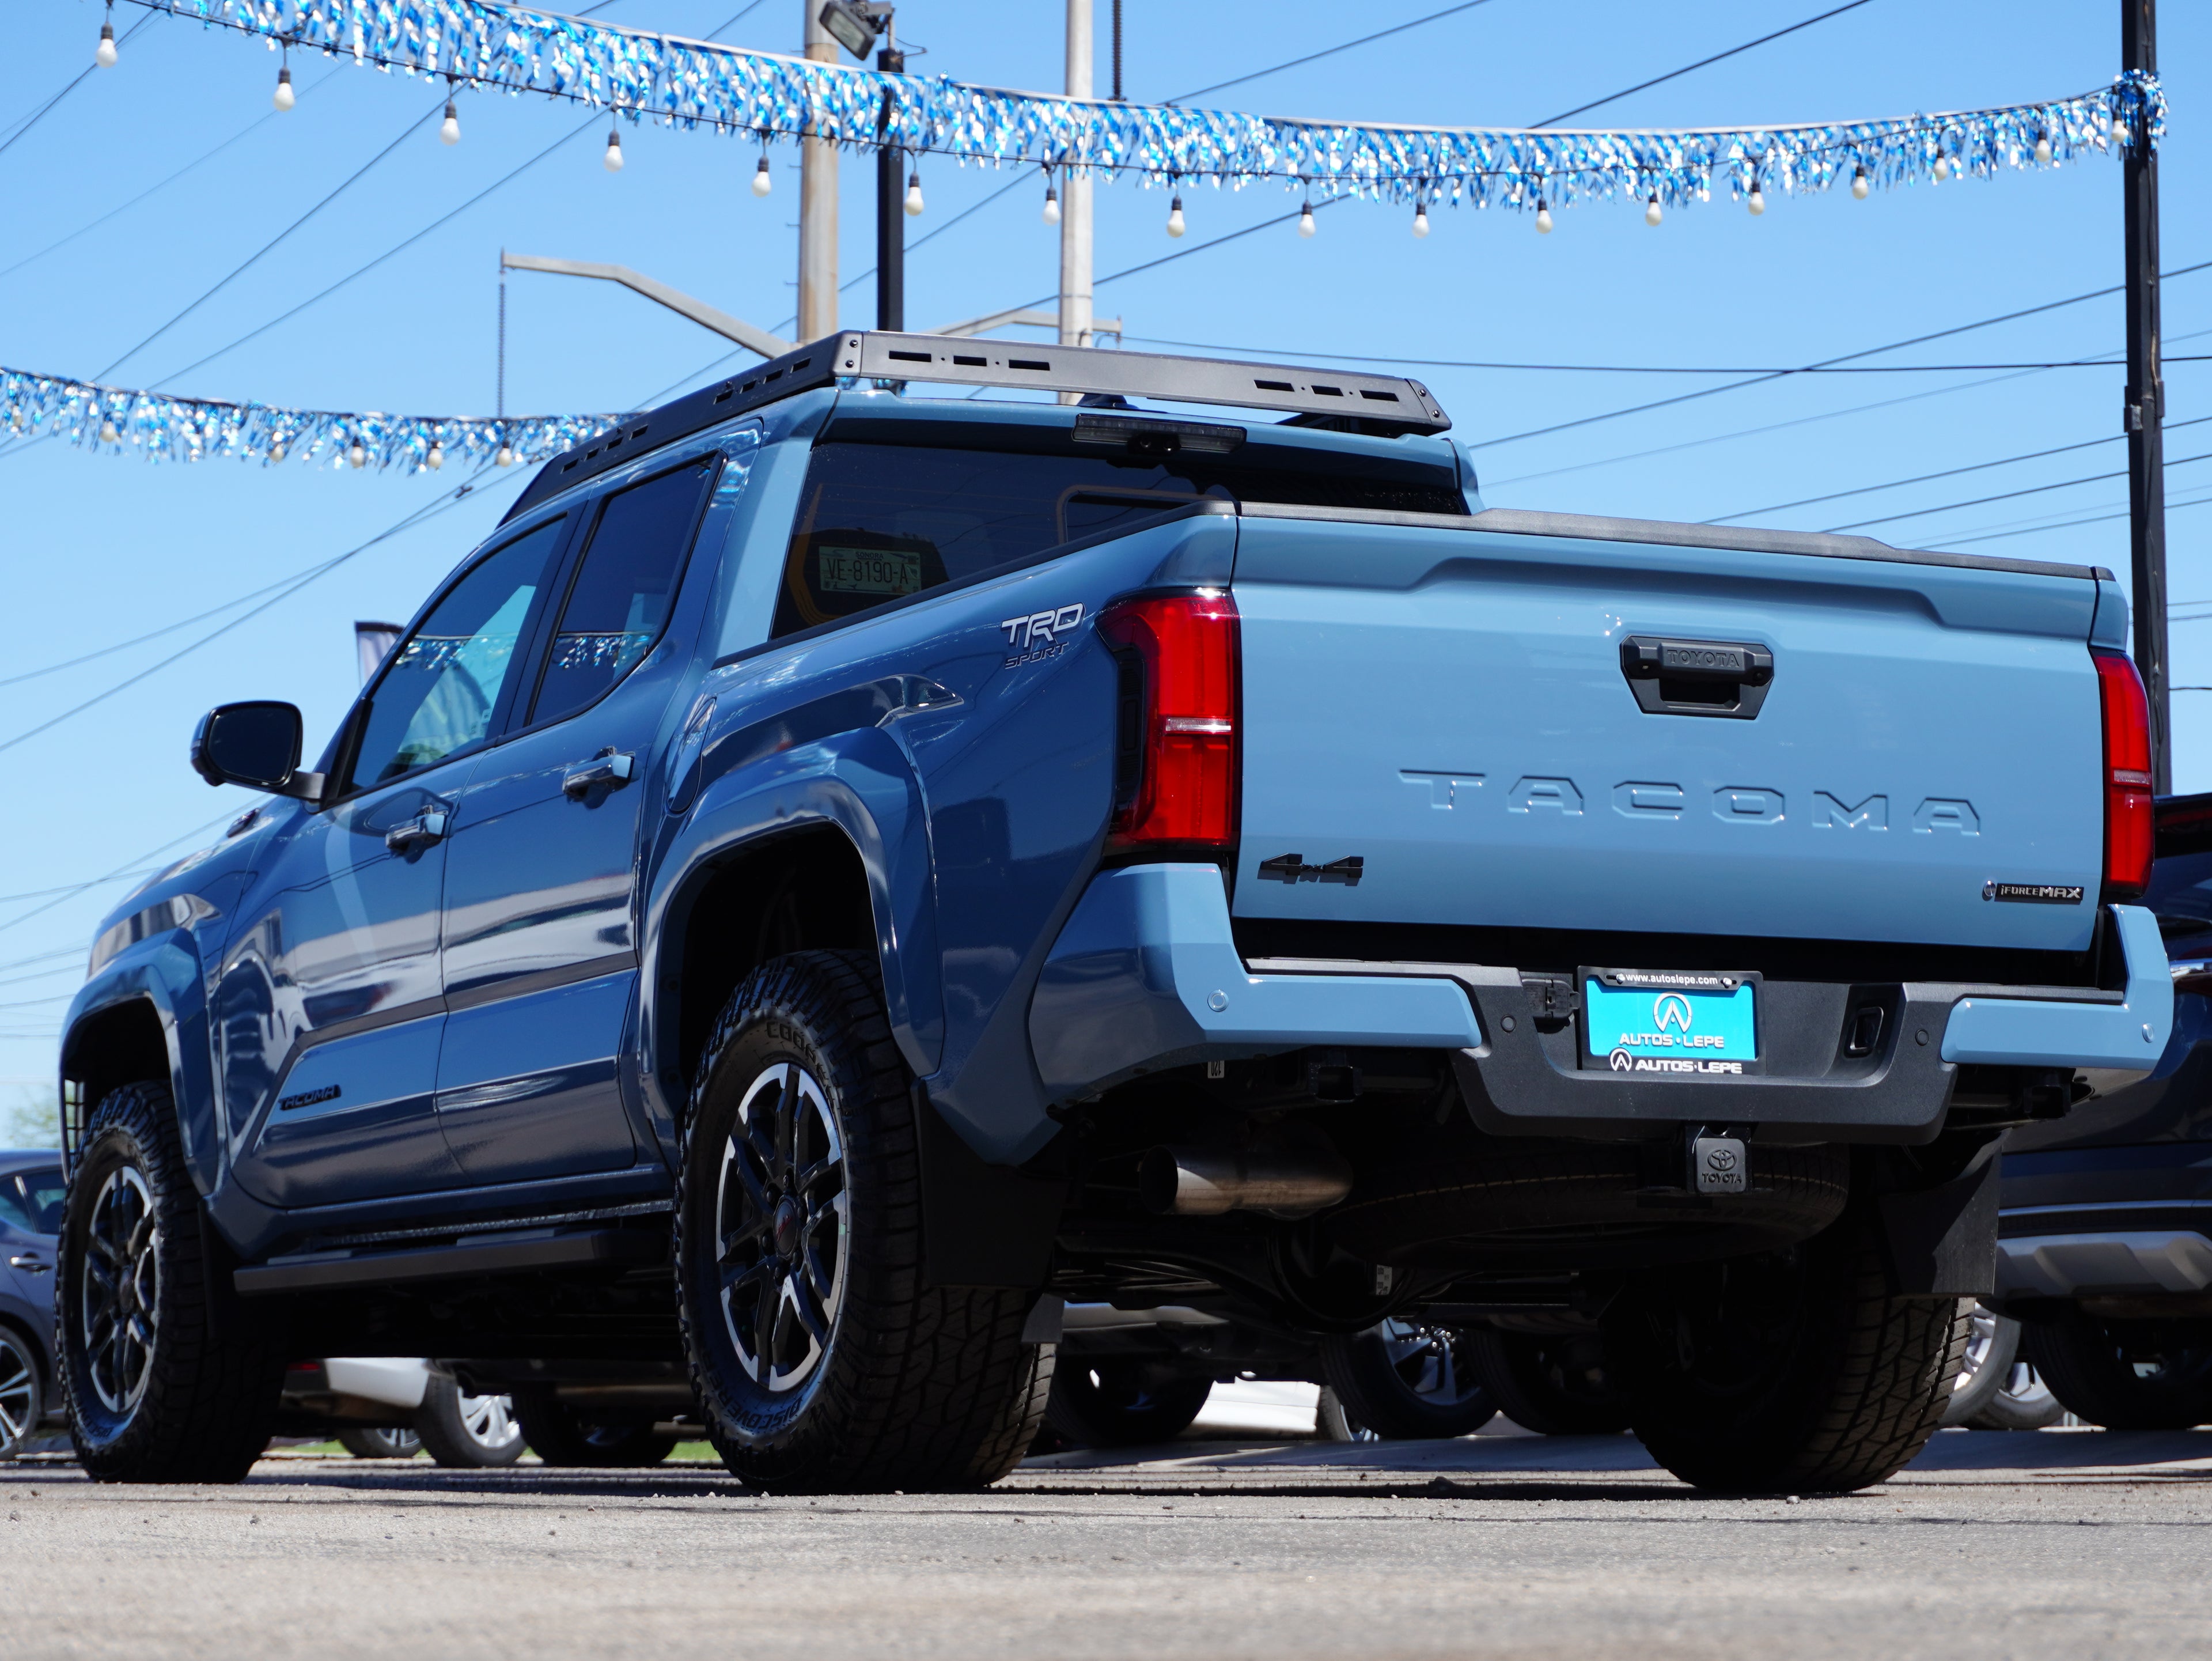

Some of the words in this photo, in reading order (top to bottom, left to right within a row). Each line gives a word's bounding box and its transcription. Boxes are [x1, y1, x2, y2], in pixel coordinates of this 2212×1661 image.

[855, 551, 884, 559] SONORA
[827, 558, 908, 584] VE-8190-A
[1001, 602, 1085, 649] TRD
[1005, 641, 1069, 669] SPORT
[1666, 649, 1740, 668] TOYOTA
[1398, 769, 1980, 836] TACOMA
[1625, 973, 1718, 986] www.autoslepe.com
[278, 1084, 339, 1110] TACOMA
[1702, 1172, 1743, 1184] TOYOTA
